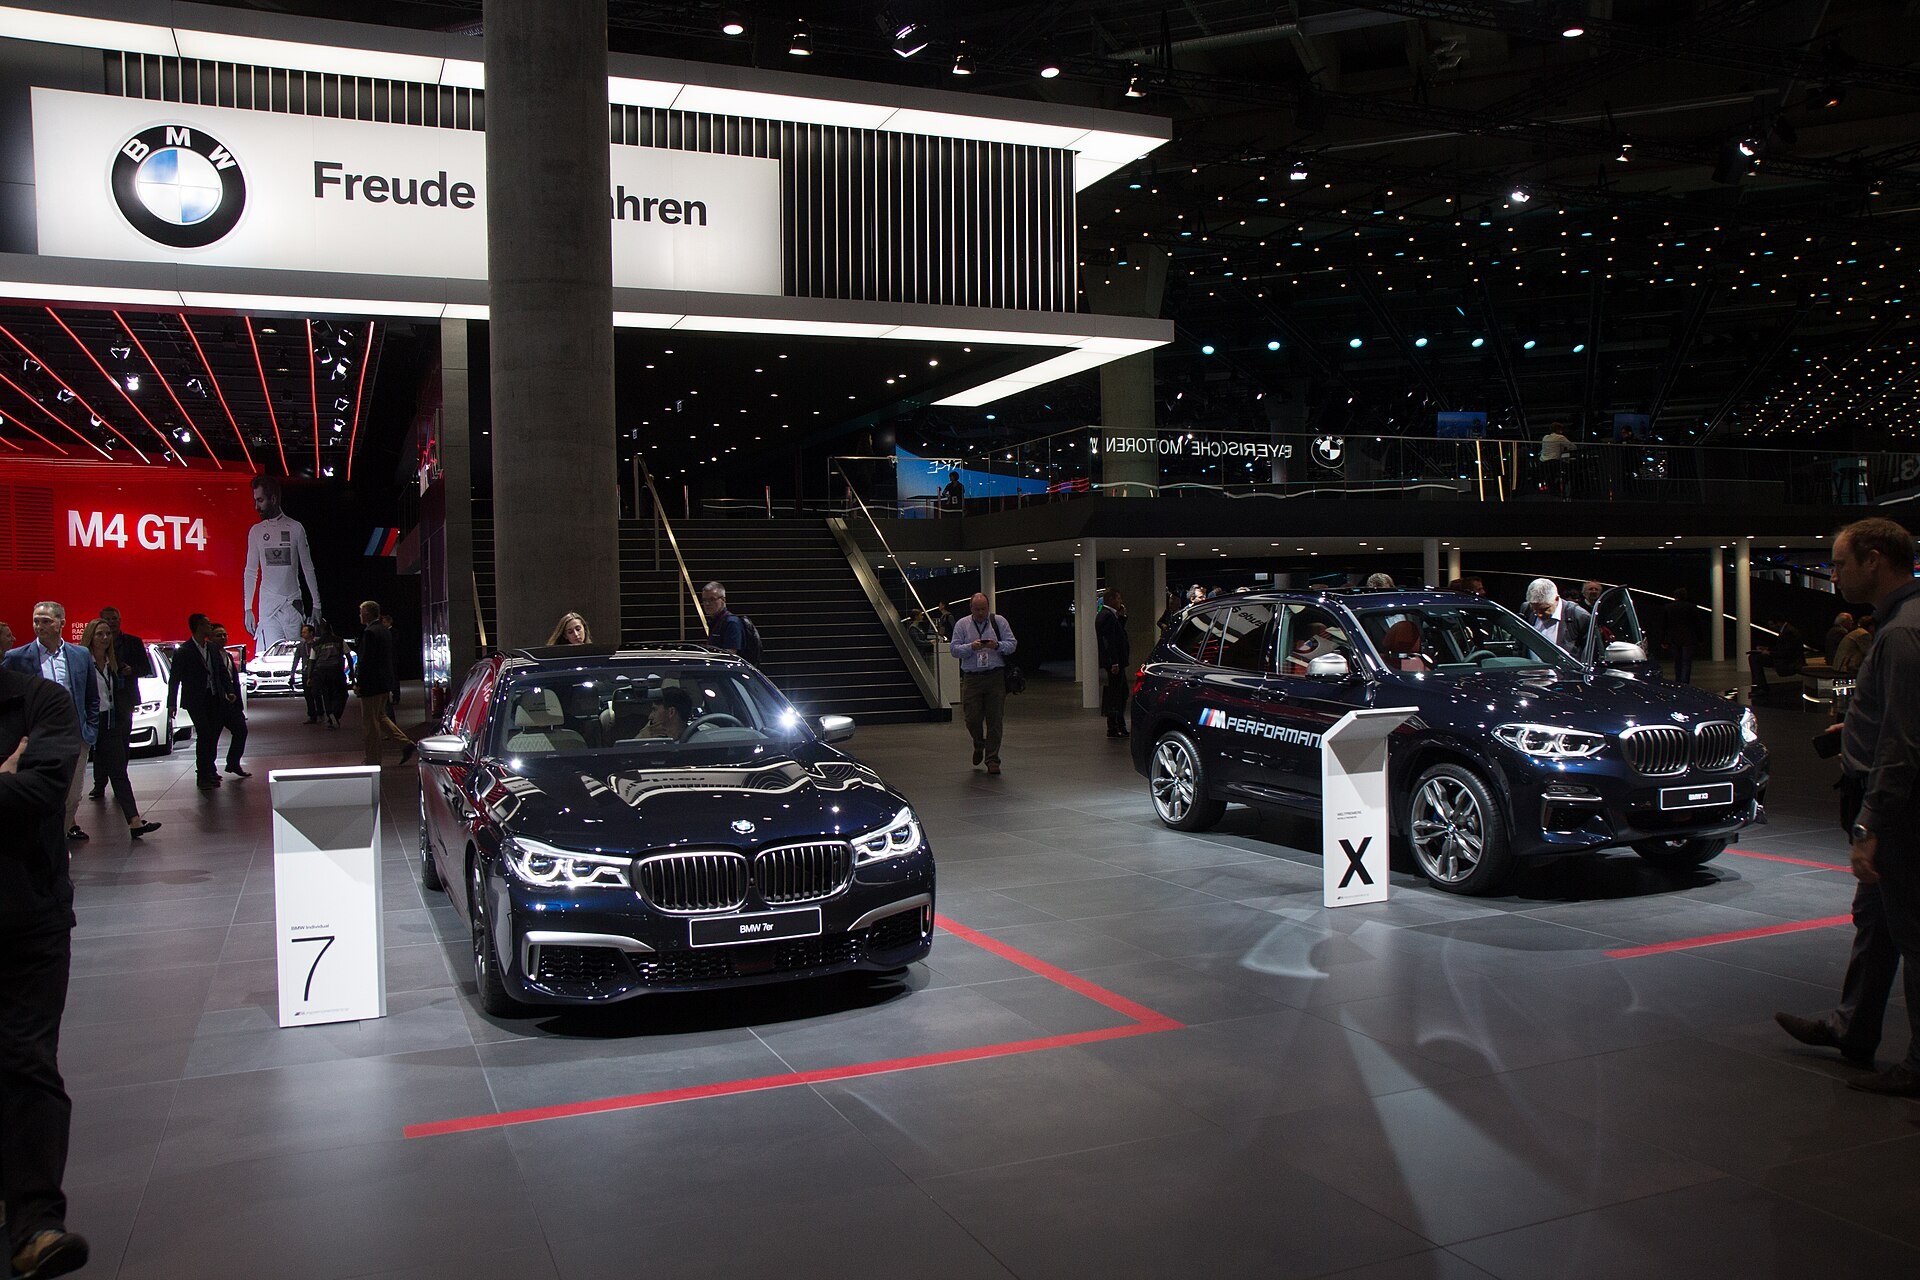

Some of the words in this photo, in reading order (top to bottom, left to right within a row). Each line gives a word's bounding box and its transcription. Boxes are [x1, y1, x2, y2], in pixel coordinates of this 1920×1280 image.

[122, 126, 237, 171] BMW
[314, 160, 476, 210] Freude
[610, 185, 707, 226] hren
[68, 509, 128, 549] M4
[137, 513, 208, 551] GT4
[1226, 716, 1322, 749] PERFORMAN
[1338, 836, 1375, 889] X
[739, 923, 761, 934] BMW
[762, 921, 774, 931] 7er
[291, 935, 335, 1002] 7
